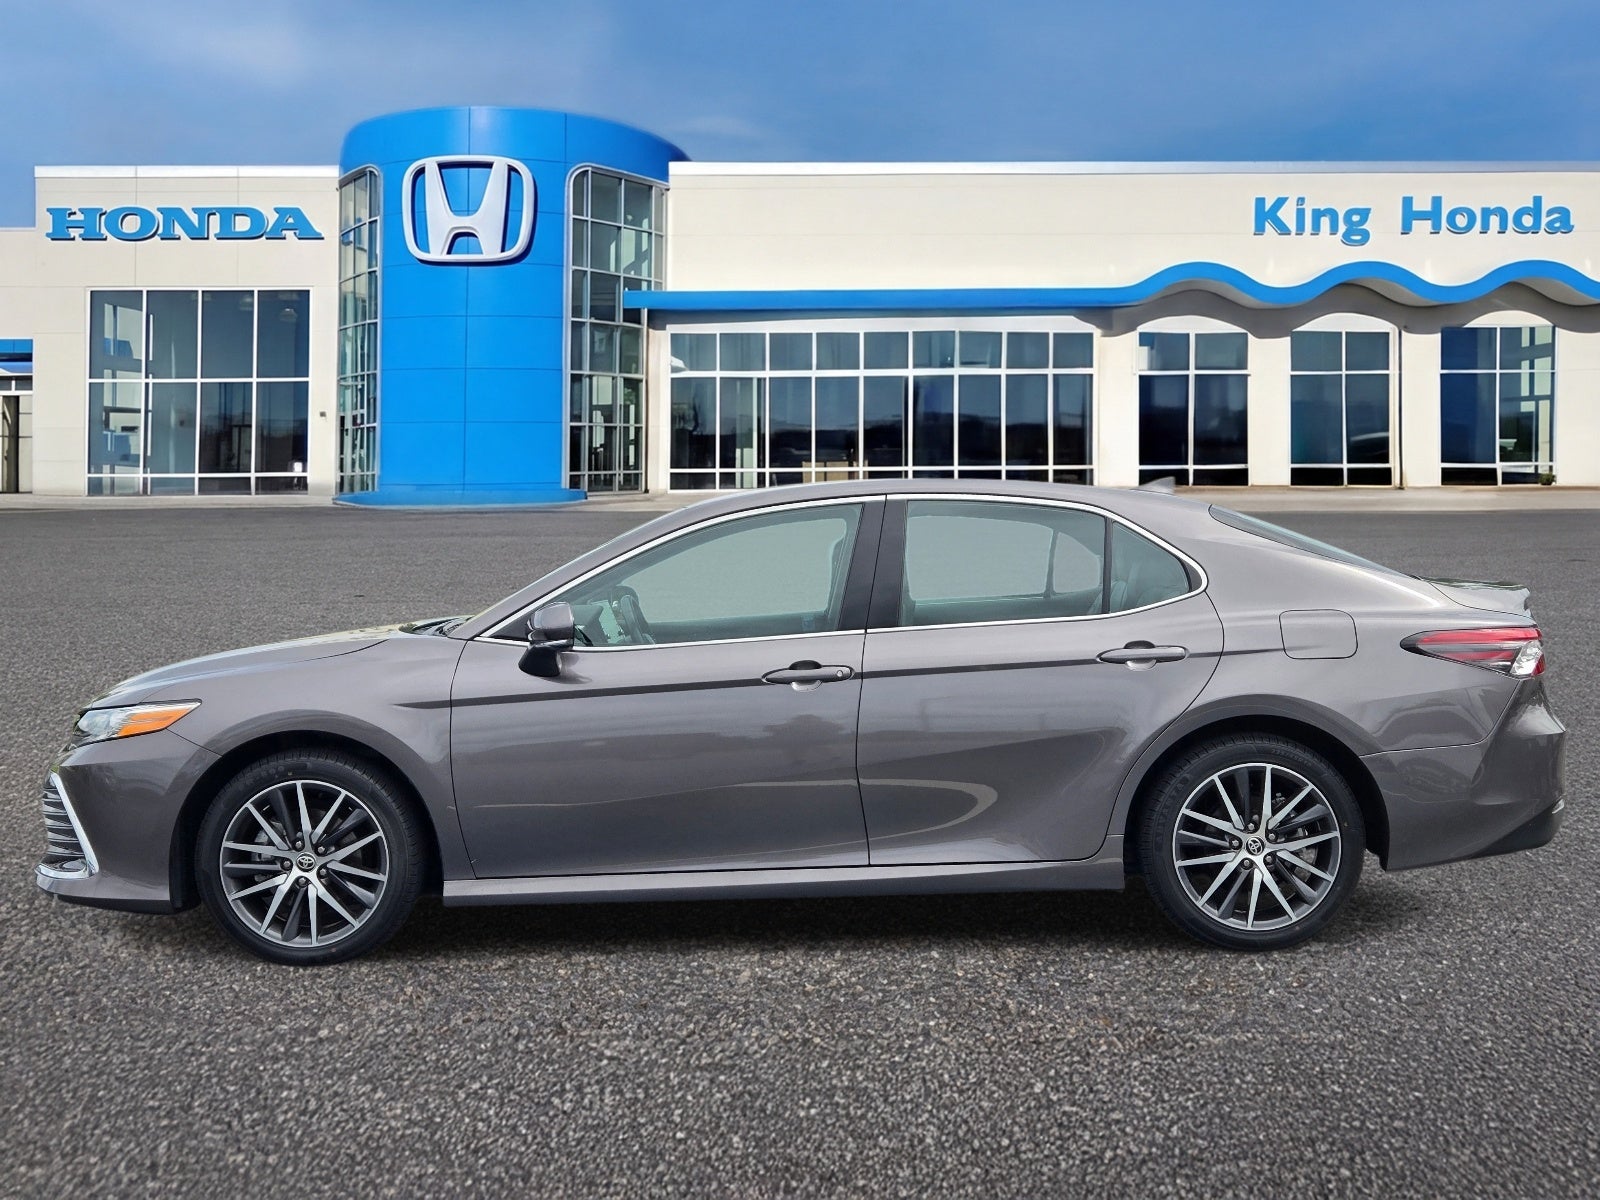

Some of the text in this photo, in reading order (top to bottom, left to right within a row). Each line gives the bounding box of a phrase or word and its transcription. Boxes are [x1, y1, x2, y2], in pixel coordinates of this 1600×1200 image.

[45, 206, 324, 241] HONDA
[1253, 195, 1575, 246] King Honda
